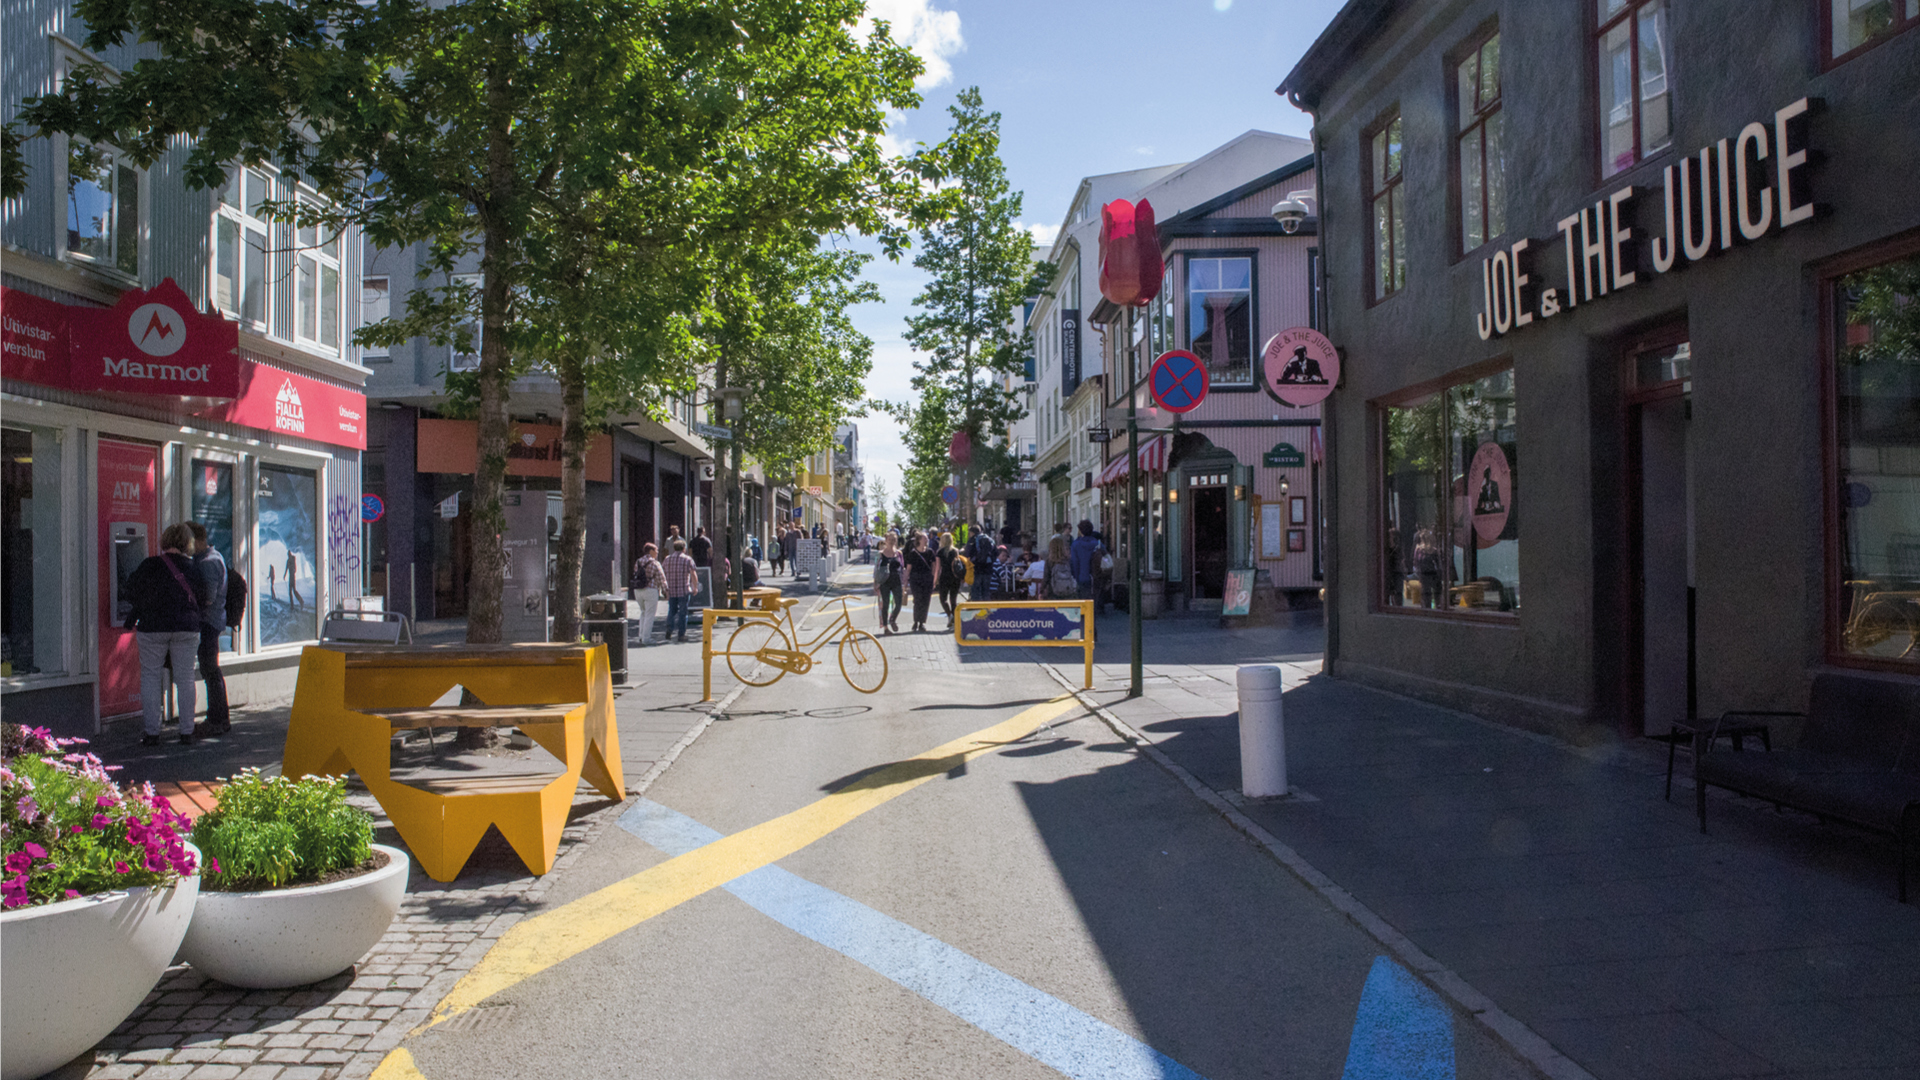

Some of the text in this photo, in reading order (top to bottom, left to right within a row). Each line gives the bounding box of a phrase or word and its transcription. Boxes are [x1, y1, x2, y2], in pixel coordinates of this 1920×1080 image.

[1478, 96, 1814, 341] JOE & THE JUICE
[3, 341, 46, 361] verslun
[1270, 331, 1334, 360] JOE & THE JUICE
[102, 356, 209, 382] Marmot
[276, 400, 304, 421] FJALLA
[276, 415, 305, 434] KOFINN
[339, 421, 358, 434] verslun
[113, 481, 140, 501] ATM
[988, 619, 1054, 629] GÖNGUGÖTUR
